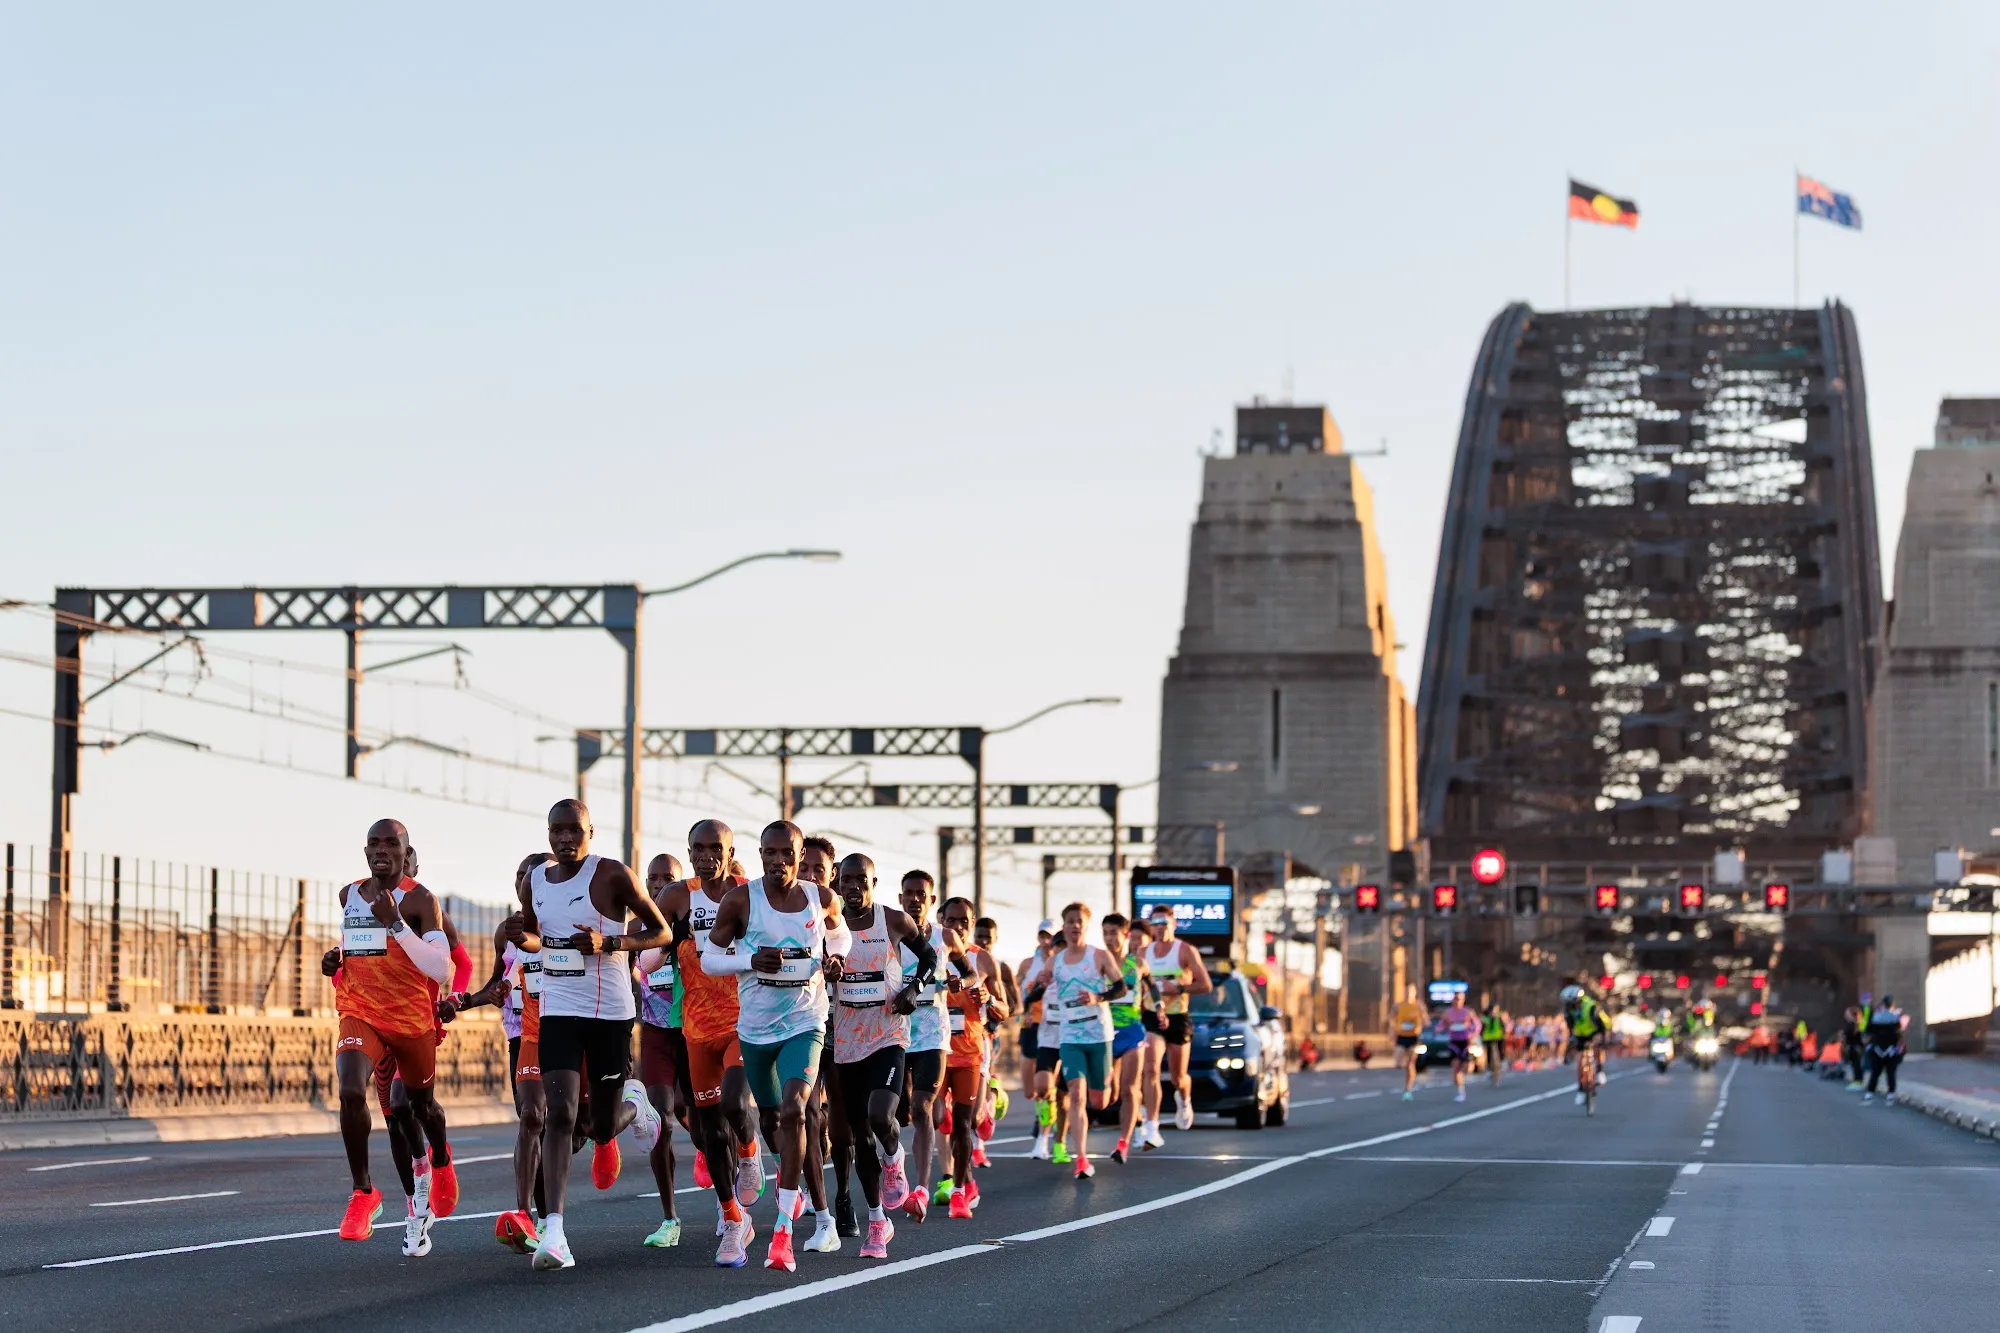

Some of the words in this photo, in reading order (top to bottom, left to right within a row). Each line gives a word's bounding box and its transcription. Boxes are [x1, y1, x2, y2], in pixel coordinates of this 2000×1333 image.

[549, 955, 569, 963] PACE2
[842, 987, 879, 996] CHESEREK
[338, 1036, 363, 1048] EOS
[694, 1086, 721, 1101] NEOS
